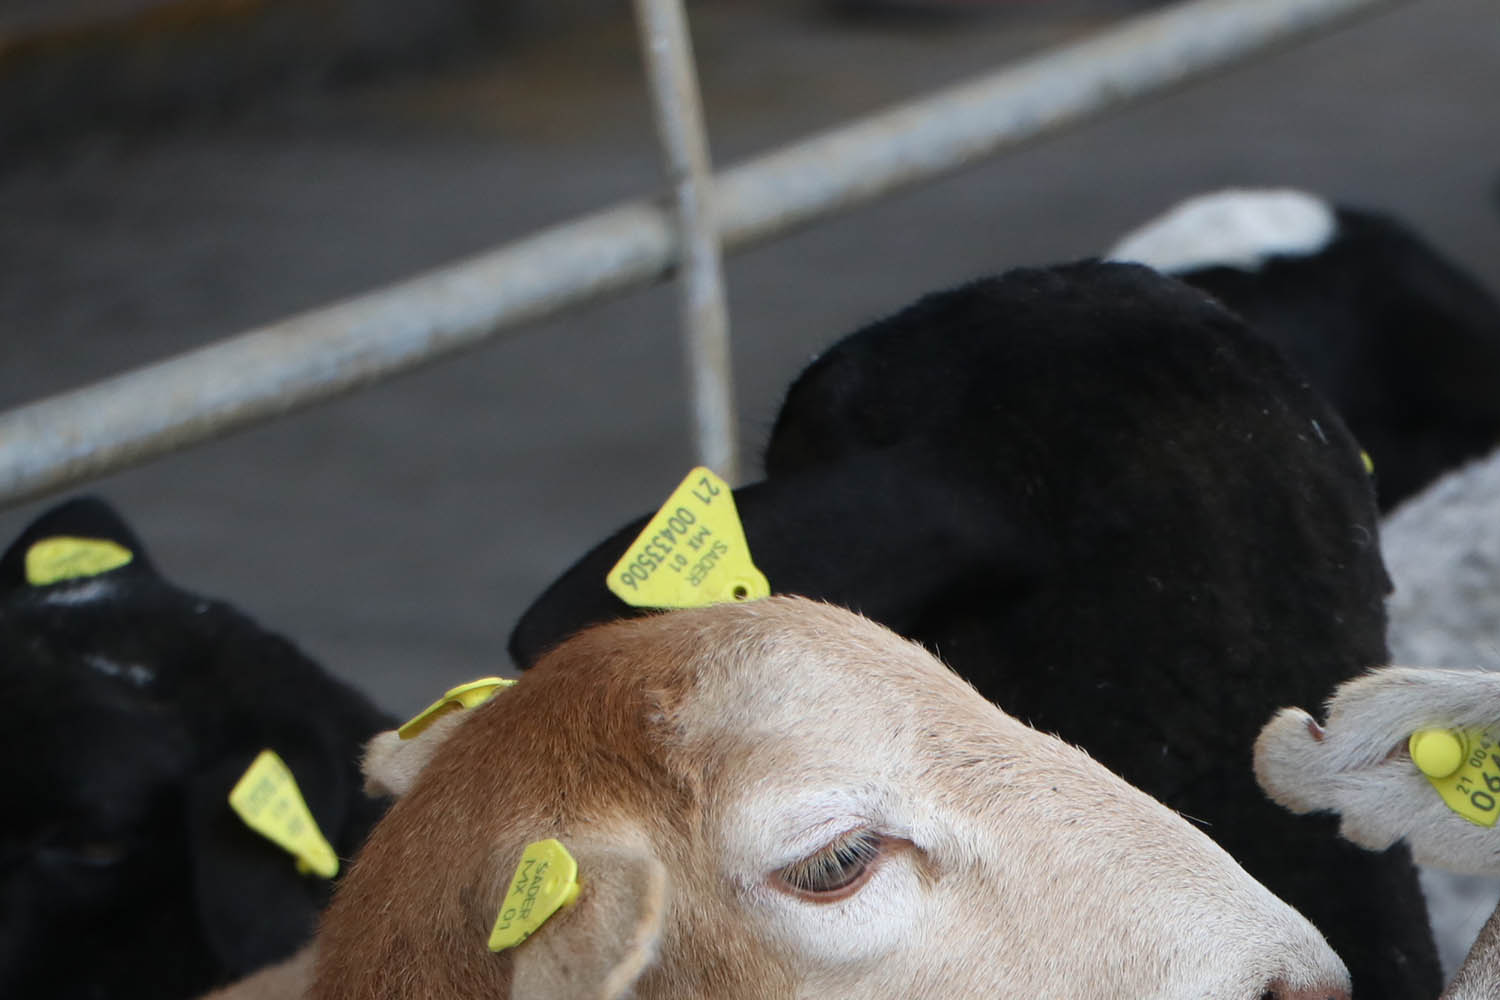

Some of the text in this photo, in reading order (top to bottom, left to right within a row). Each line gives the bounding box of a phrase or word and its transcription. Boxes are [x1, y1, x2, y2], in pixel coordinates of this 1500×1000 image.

[619, 477, 720, 591] 21 00433506
[668, 525, 713, 573] MX 01
[685, 540, 728, 587] SADER
[1456, 776, 1473, 795] 21
[512, 859, 536, 896] MX
[519, 861, 549, 920] SADER
